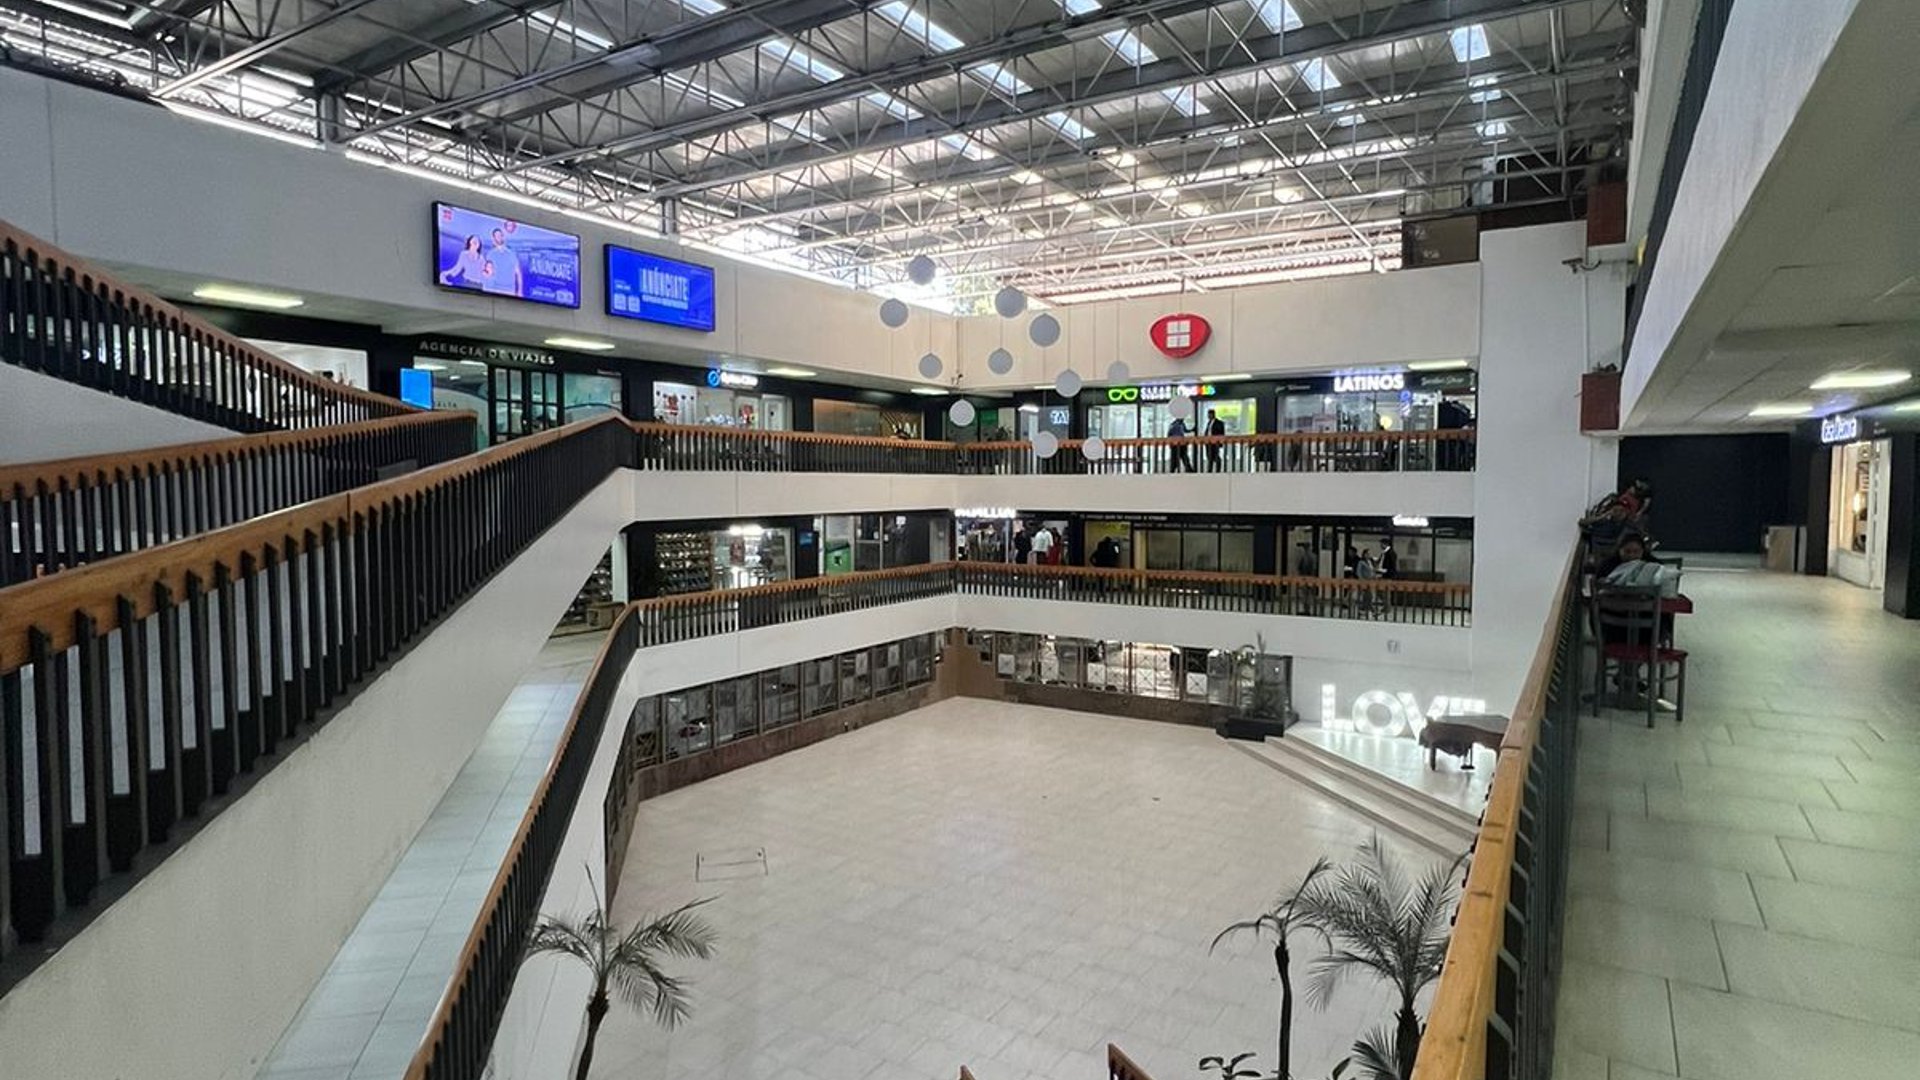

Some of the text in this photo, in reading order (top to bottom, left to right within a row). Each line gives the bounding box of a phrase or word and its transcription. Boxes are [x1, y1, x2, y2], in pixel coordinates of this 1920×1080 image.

[419, 339, 483, 357] AGENCIA
[508, 350, 556, 366] VIAJES
[1333, 373, 1405, 393] LATINOS
